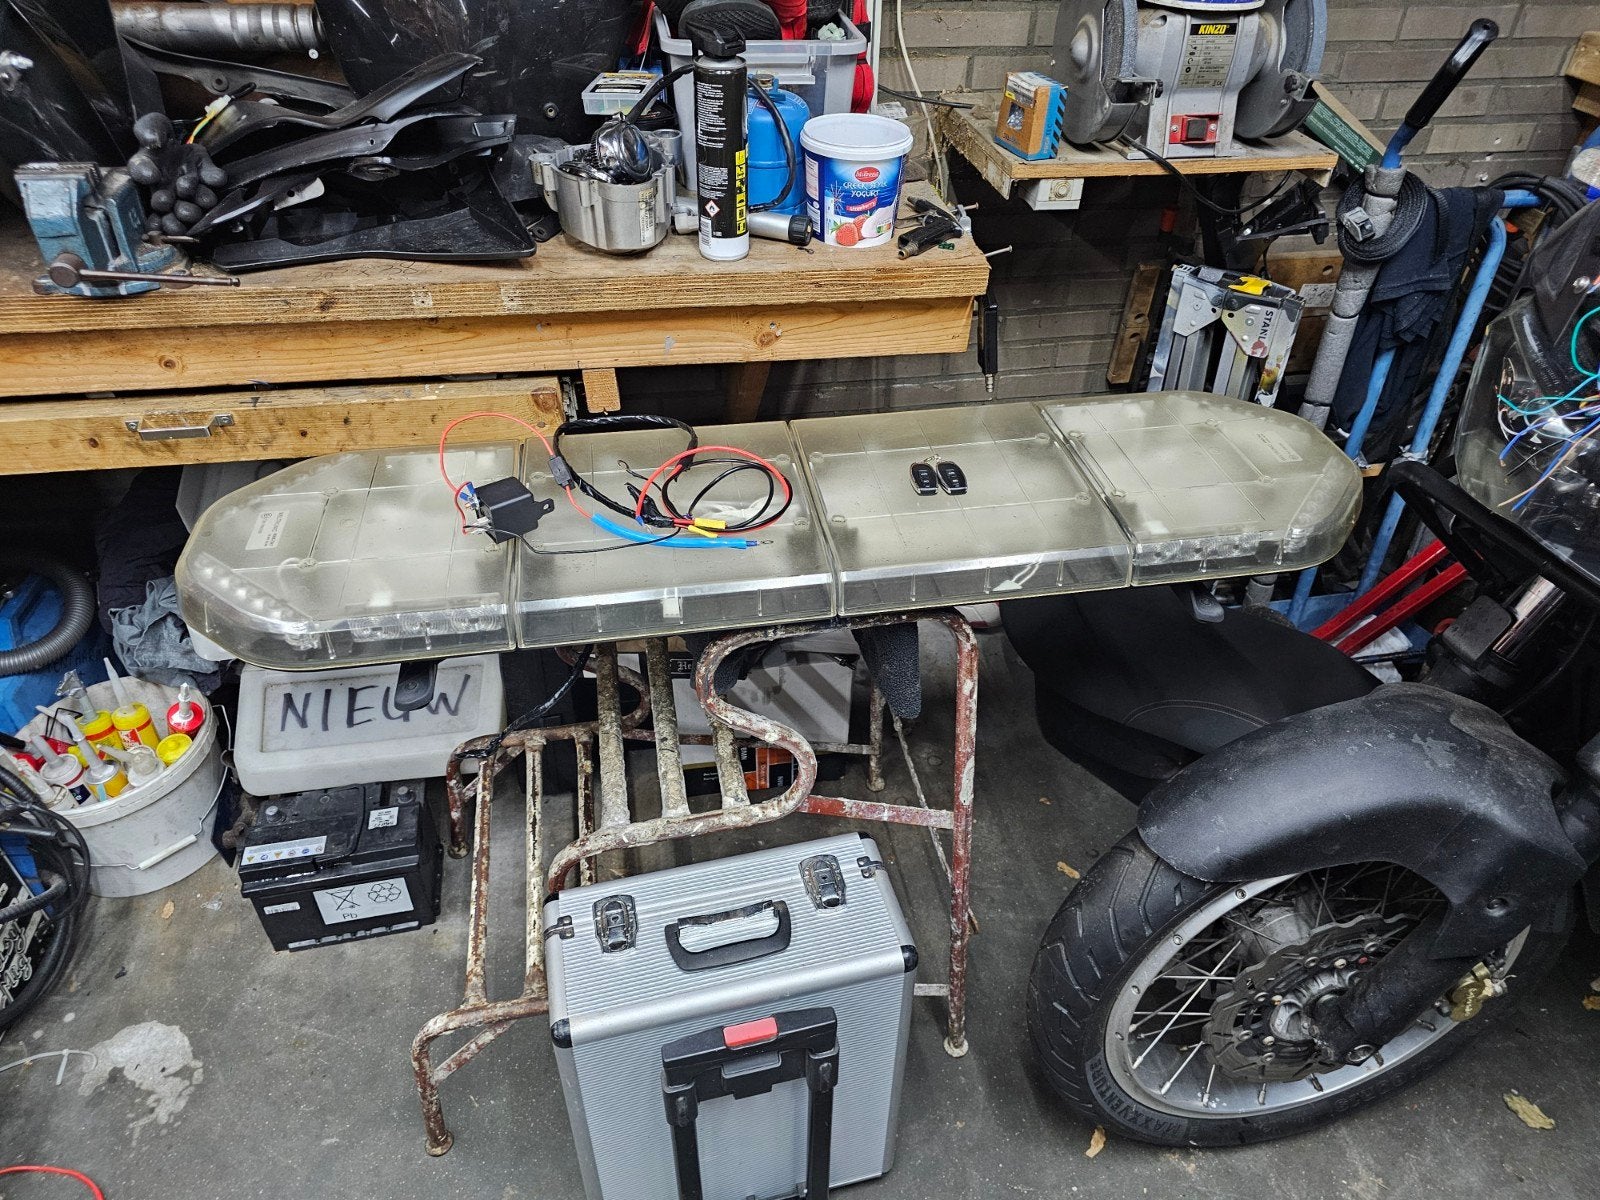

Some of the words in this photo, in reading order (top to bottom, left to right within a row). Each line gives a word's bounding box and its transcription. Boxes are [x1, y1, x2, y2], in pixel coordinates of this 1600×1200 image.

[1198, 24, 1227, 35] KINZO
[851, 189, 880, 198] YOGURT
[1258, 310, 1274, 340] STANL
[342, 912, 358, 920] Pb
[1090, 1062, 1183, 1135] MAXXVENTURE
